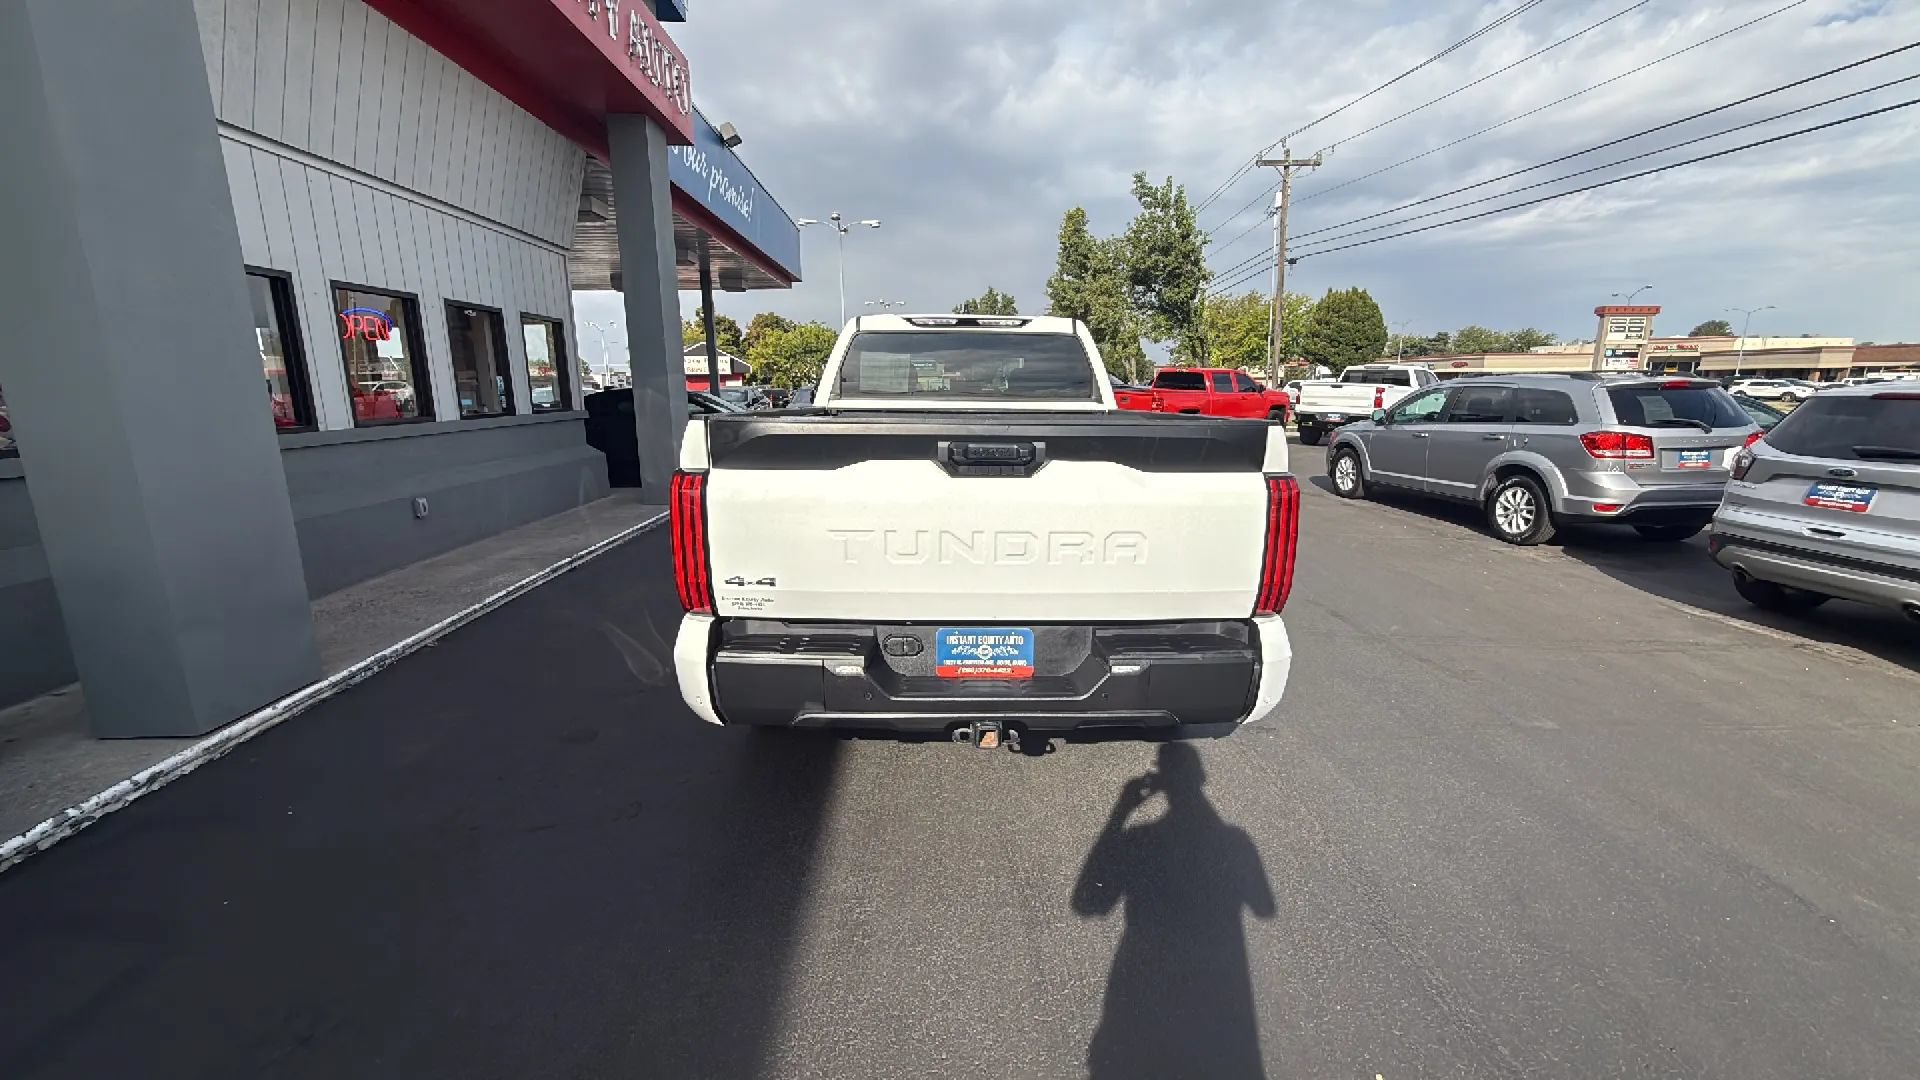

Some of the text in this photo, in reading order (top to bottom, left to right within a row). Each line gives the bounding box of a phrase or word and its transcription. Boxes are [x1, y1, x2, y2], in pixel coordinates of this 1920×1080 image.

[707, 164, 755, 223] promise!
[827, 528, 1150, 566] TUNDRA
[946, 636, 1023, 644] INSTANT EQUITY AUTO
